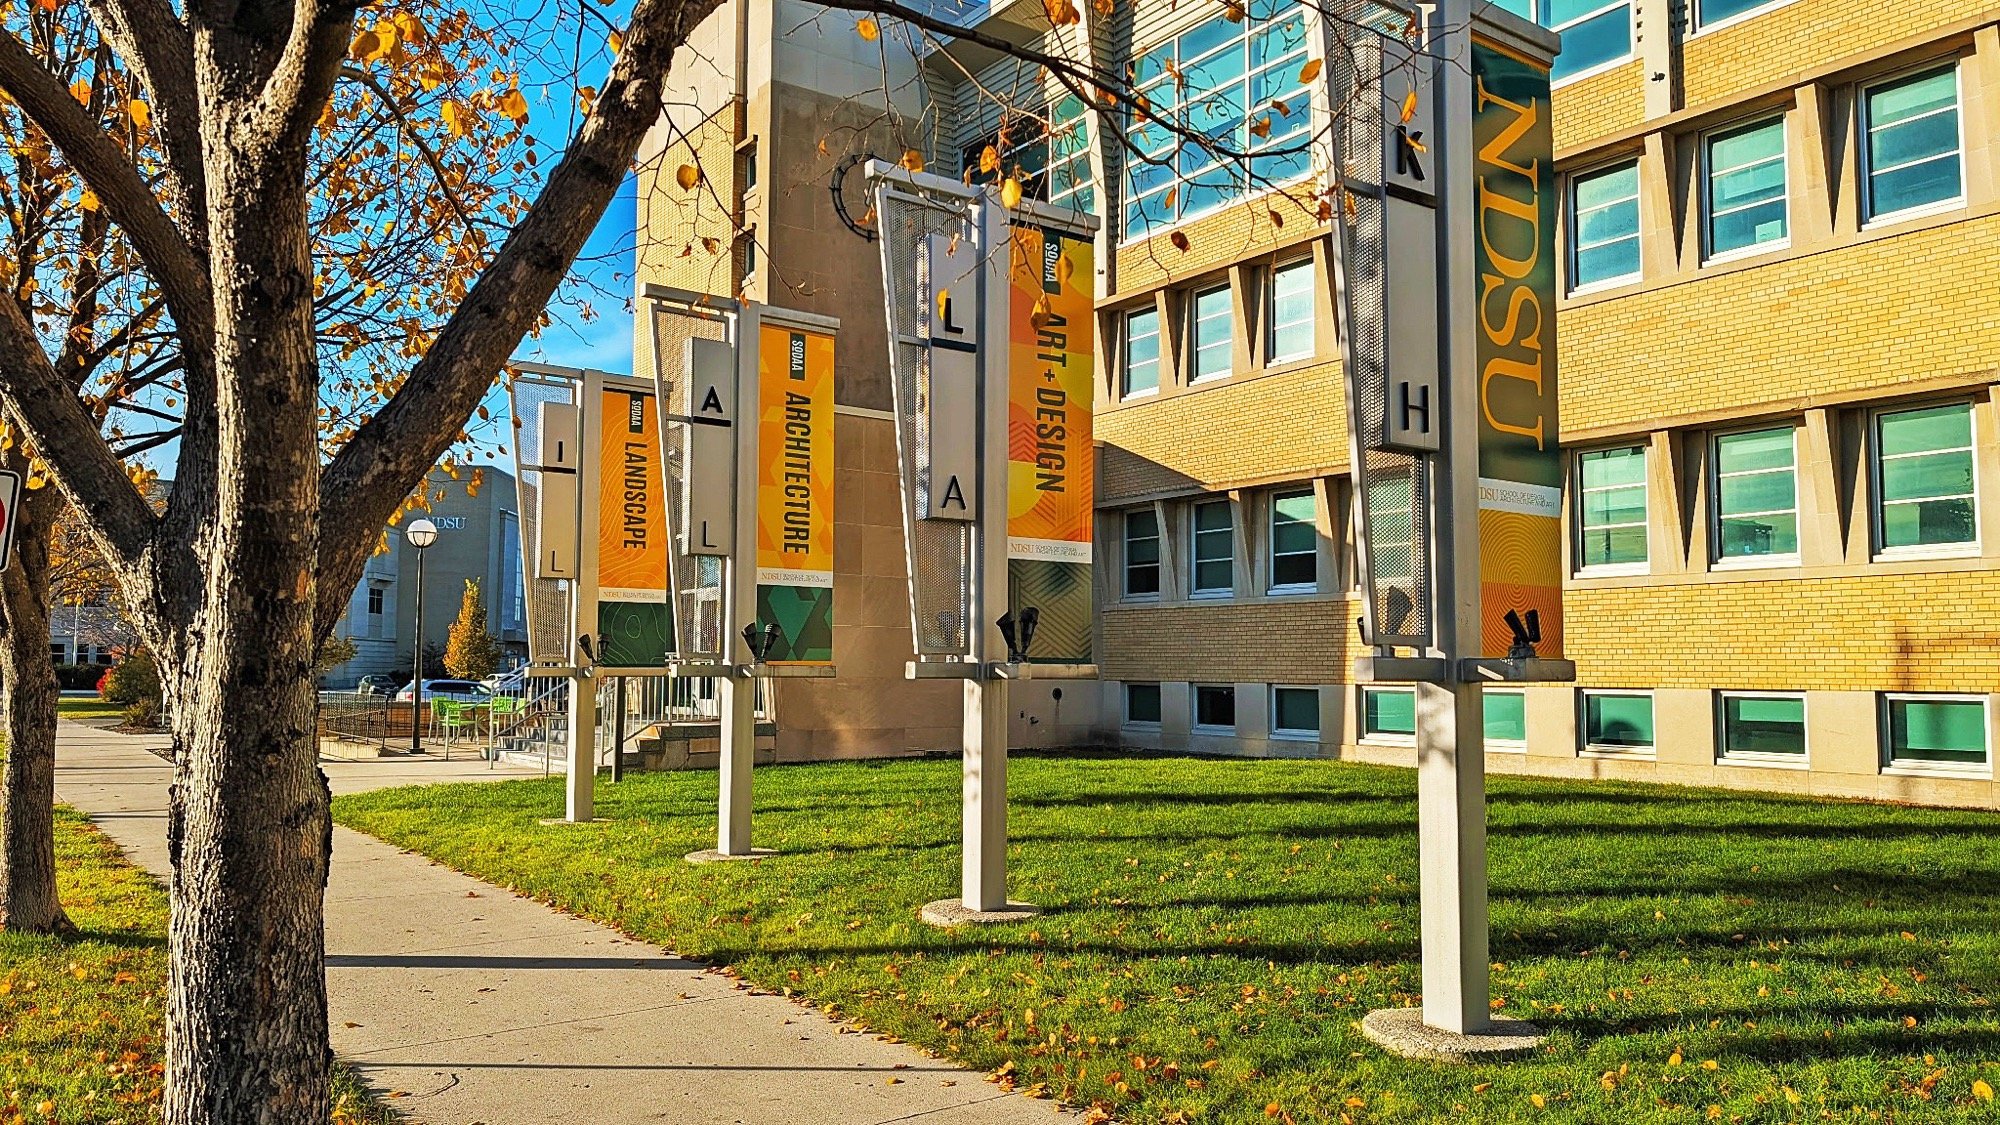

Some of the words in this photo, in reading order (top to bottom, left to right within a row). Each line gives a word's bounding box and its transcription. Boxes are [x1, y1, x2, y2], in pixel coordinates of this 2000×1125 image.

[1397, 125, 1425, 181] K
[1478, 73, 1545, 452] NDSU
[944, 297, 964, 334] L
[1037, 312, 1067, 368] ART
[701, 386, 724, 414] A
[1401, 381, 1430, 434] H
[1035, 387, 1067, 493] DESIGN
[623, 441, 648, 550] LANDSCAPE
[783, 391, 812, 555] ARCHITECTURE
[942, 474, 967, 511] A
[1480, 486, 1499, 501] DSU
[703, 521, 718, 548] L
[1010, 543, 1034, 554] NDSU
[551, 550, 564, 573] L
